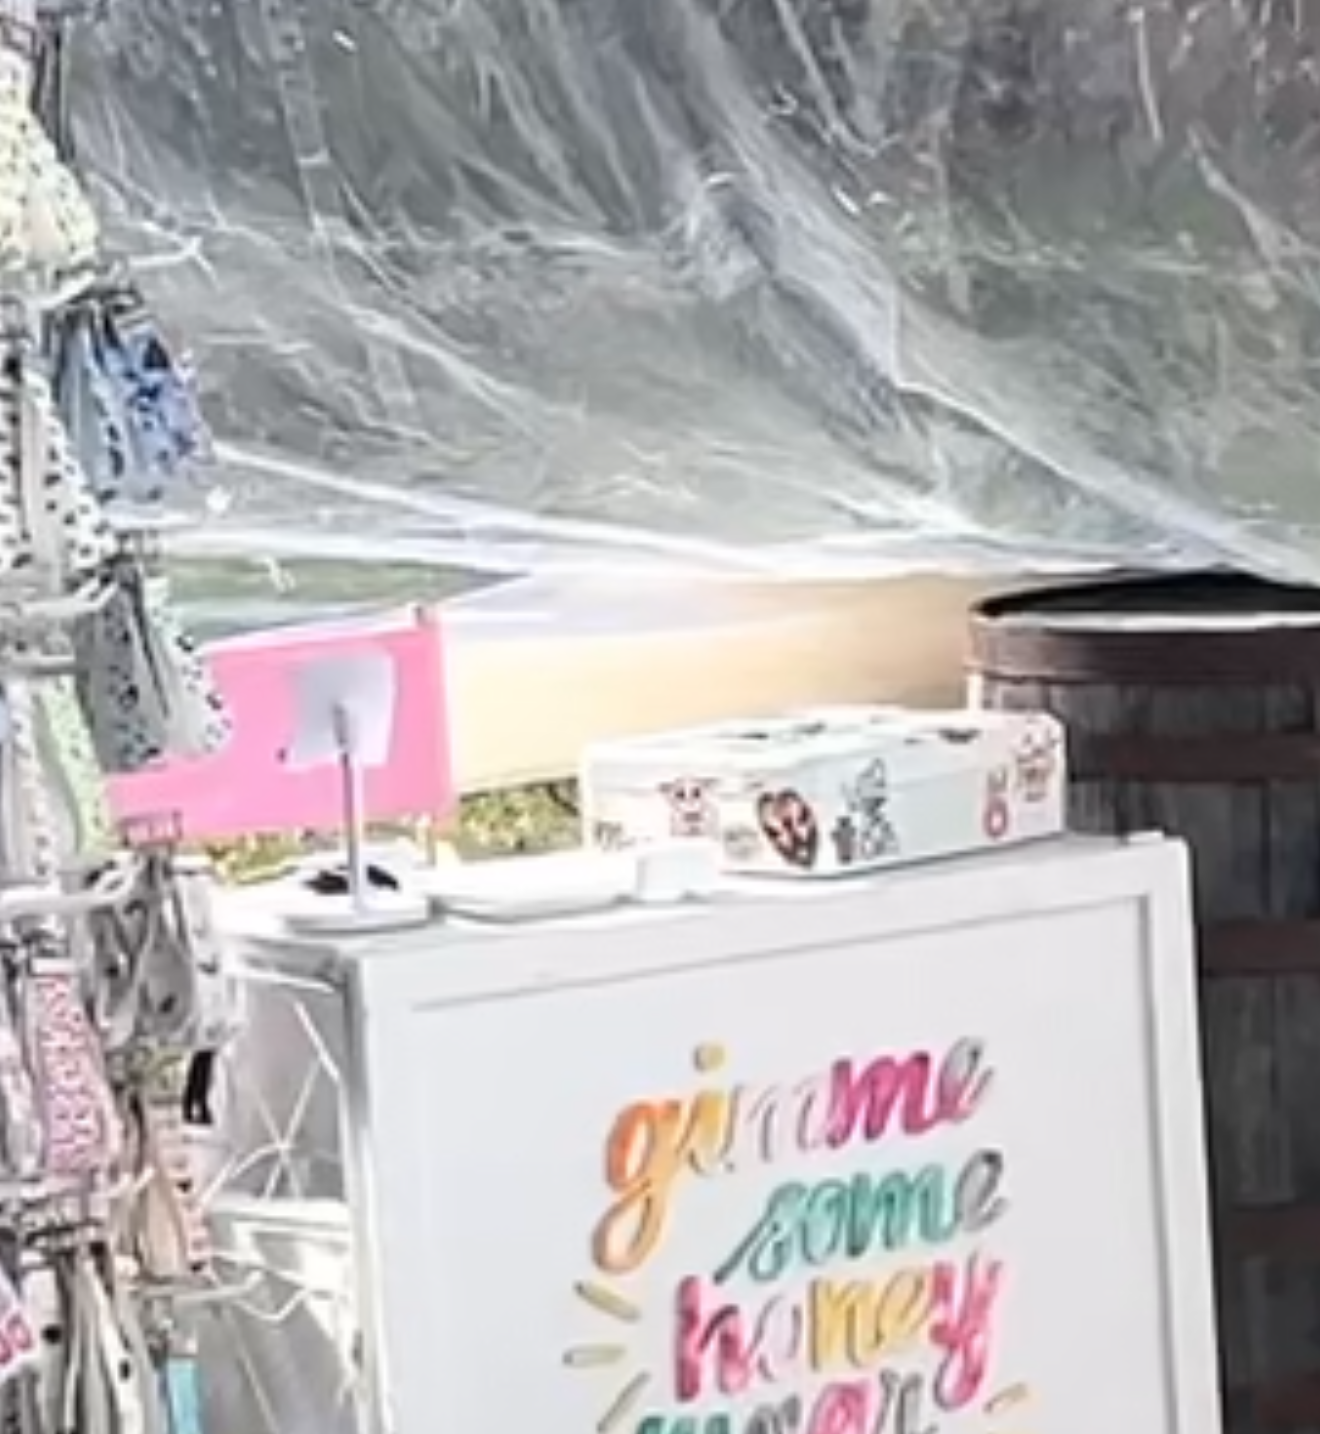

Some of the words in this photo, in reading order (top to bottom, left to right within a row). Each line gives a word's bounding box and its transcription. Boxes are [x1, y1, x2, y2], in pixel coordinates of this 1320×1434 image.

[590, 1037, 996, 1275] gimme
[713, 1149, 1007, 1284] some
[675, 1252, 1003, 1411] honey
